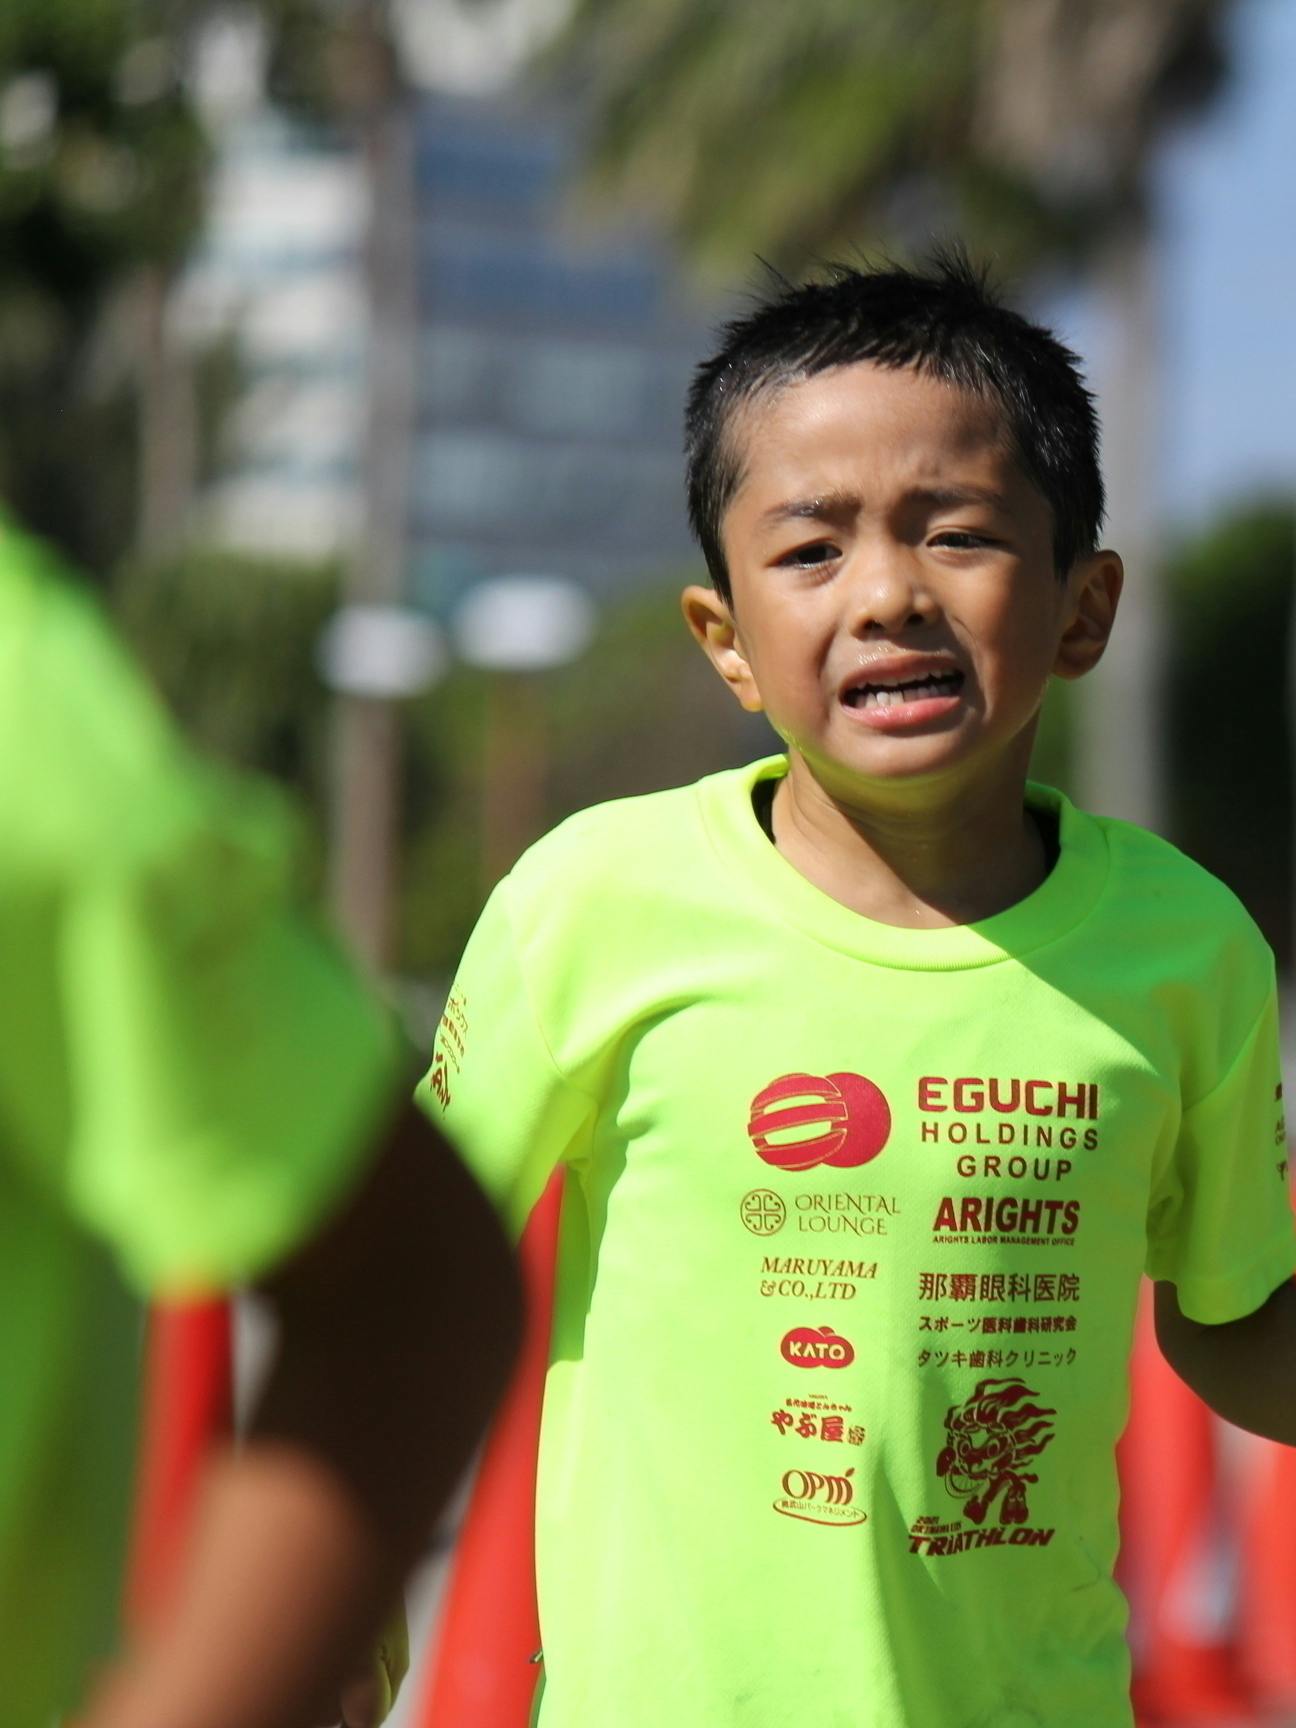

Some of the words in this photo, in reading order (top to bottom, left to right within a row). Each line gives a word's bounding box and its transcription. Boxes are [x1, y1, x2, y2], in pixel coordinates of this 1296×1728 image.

[918, 1076, 1098, 1120] EGUCHI
[922, 1121, 1098, 1151] HOLDINGS
[957, 1155, 1072, 1182] GROUP
[795, 1192, 901, 1216] ORIENTAL
[932, 1196, 1080, 1235] ARIGHTS
[799, 1214, 887, 1237] LOUNGE
[934, 1235, 969, 1245] ARIGHTS
[971, 1236, 998, 1245] LABOR
[1000, 1236, 1050, 1246] MANAGEMENT
[1051, 1237, 1075, 1246] OFFICE
[761, 1256, 878, 1279] MARUYAMA
[919, 1272, 1080, 1302] 那覇眼科医院
[789, 1341, 846, 1360] KATO
[908, 1526, 1055, 1556] TRIATHLON
